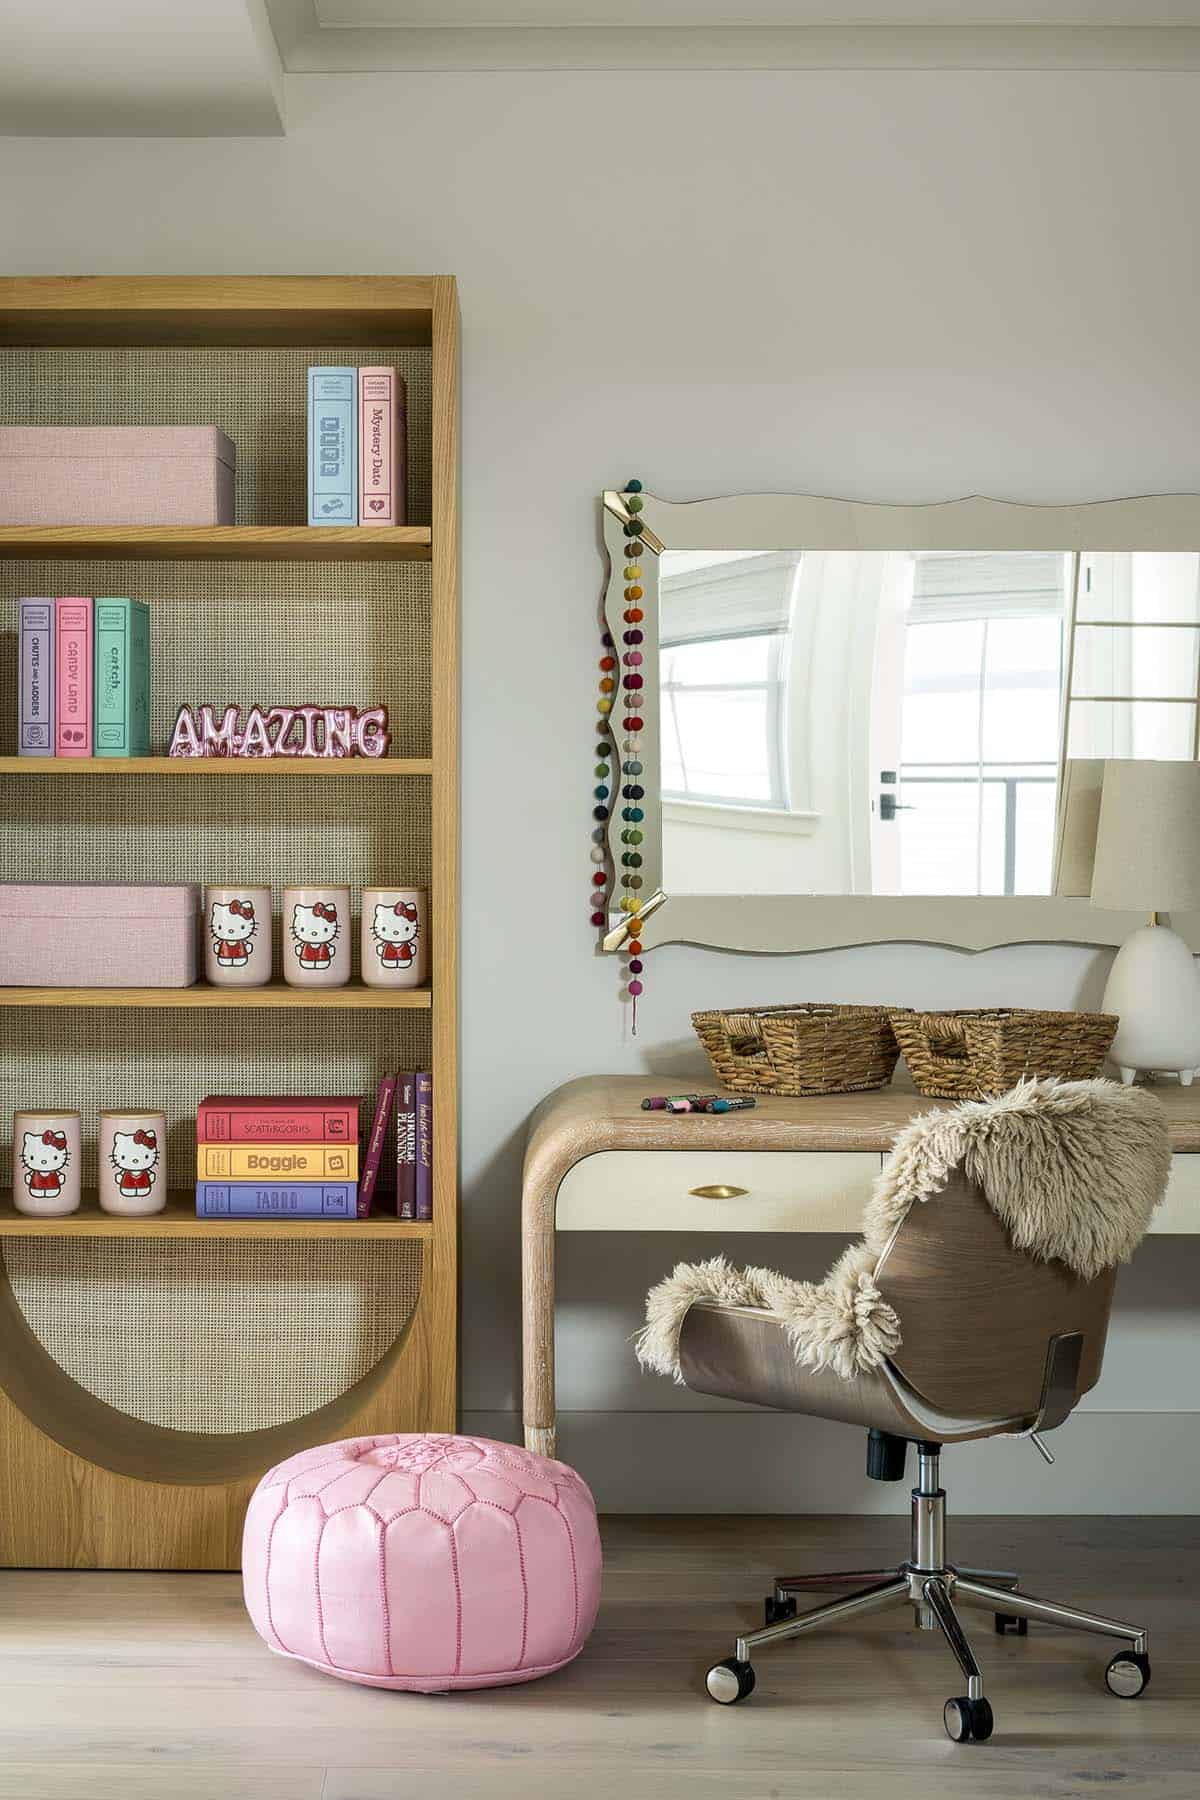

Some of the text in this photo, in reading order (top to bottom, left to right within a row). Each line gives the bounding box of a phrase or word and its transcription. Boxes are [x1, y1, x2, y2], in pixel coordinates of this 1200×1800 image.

[320, 417, 340, 476] LIFE
[371, 408, 383, 457] Mystery
[372, 458, 383, 486] Date
[31, 637, 40, 667] CHUTES
[111, 647, 121, 689] catch
[31, 681, 40, 716] LADDERS
[67, 641, 78, 713] CANDY LAND
[169, 704, 390, 758] AMAZING
[397, 1113, 407, 1164] PLANNING
[407, 1112, 416, 1164] STRATEGIC
[248, 1154, 307, 1171] Boggle
[255, 1191, 298, 1209] TABOO
